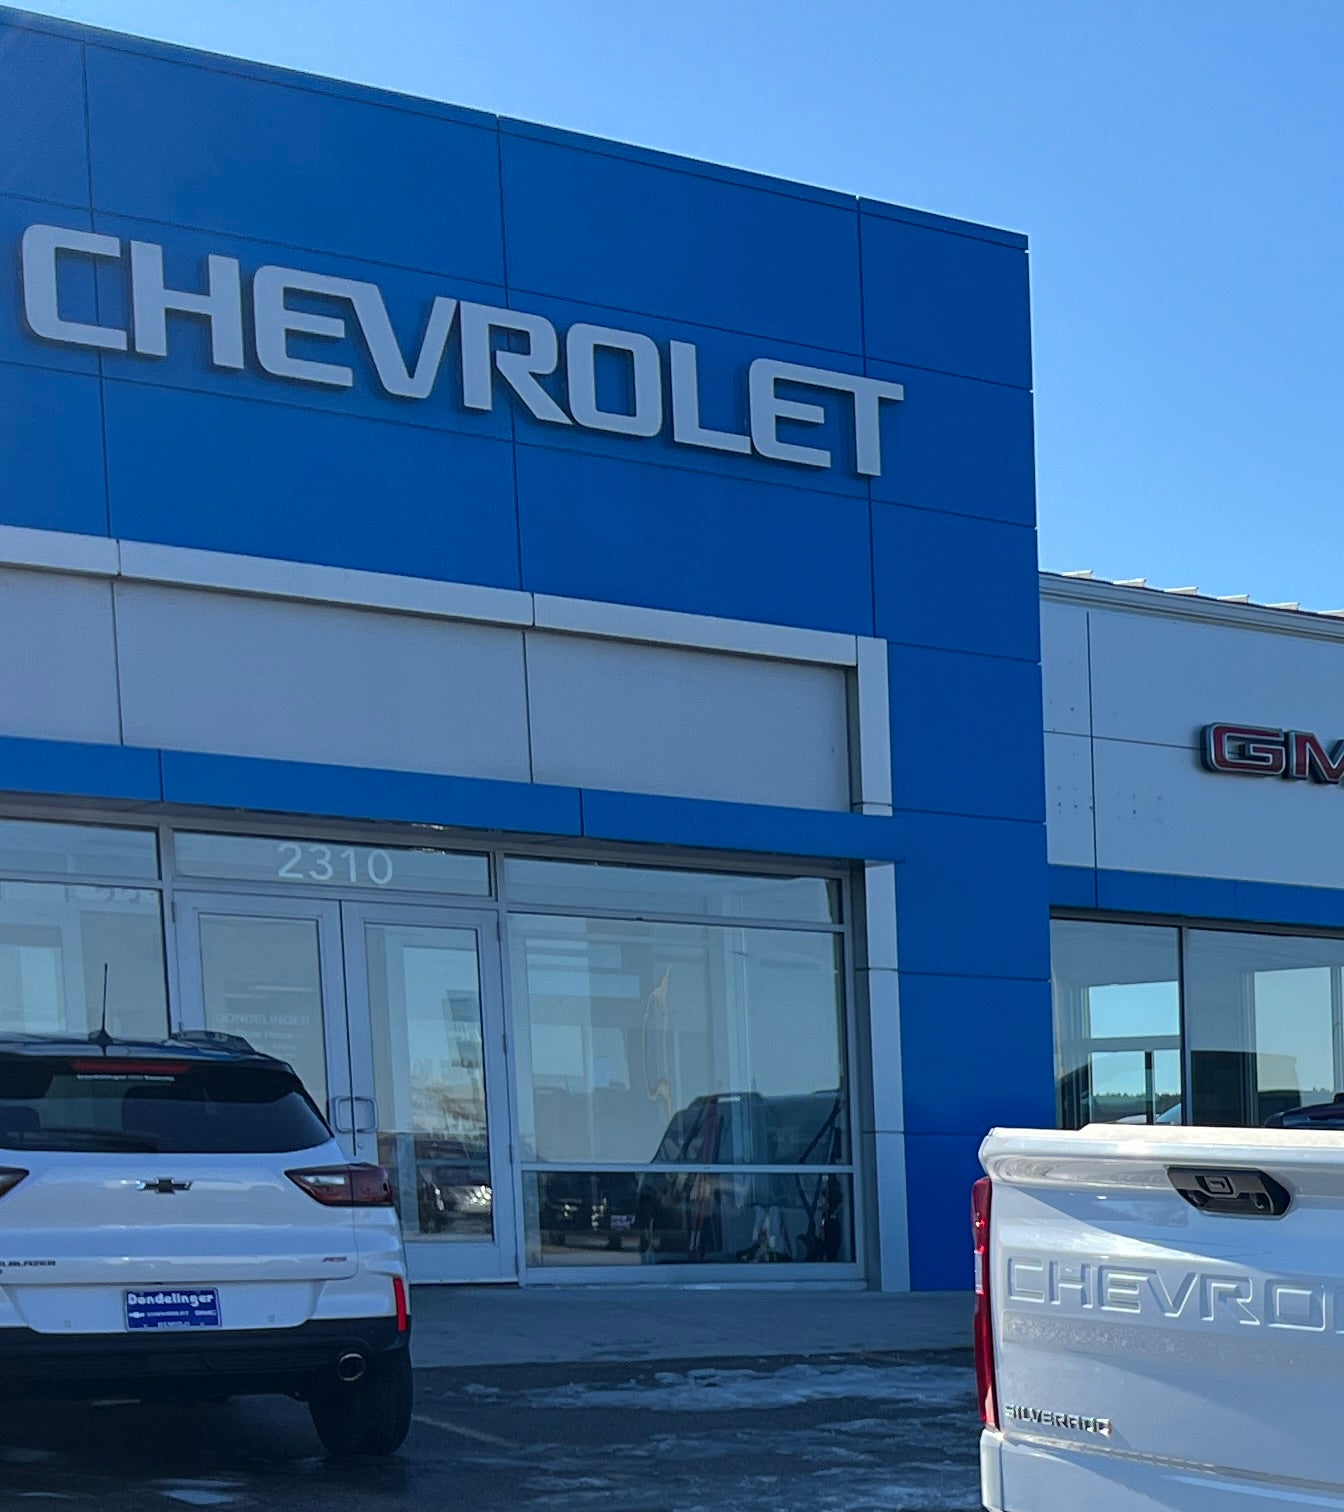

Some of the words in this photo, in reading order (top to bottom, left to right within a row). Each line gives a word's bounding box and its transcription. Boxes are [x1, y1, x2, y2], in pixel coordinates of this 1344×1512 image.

[21, 222, 904, 477] CHEVROLET
[277, 842, 393, 885] 2310
[128, 1292, 214, 1307] Dondelinger
[1005, 1403, 1113, 1437] SILVERADO
